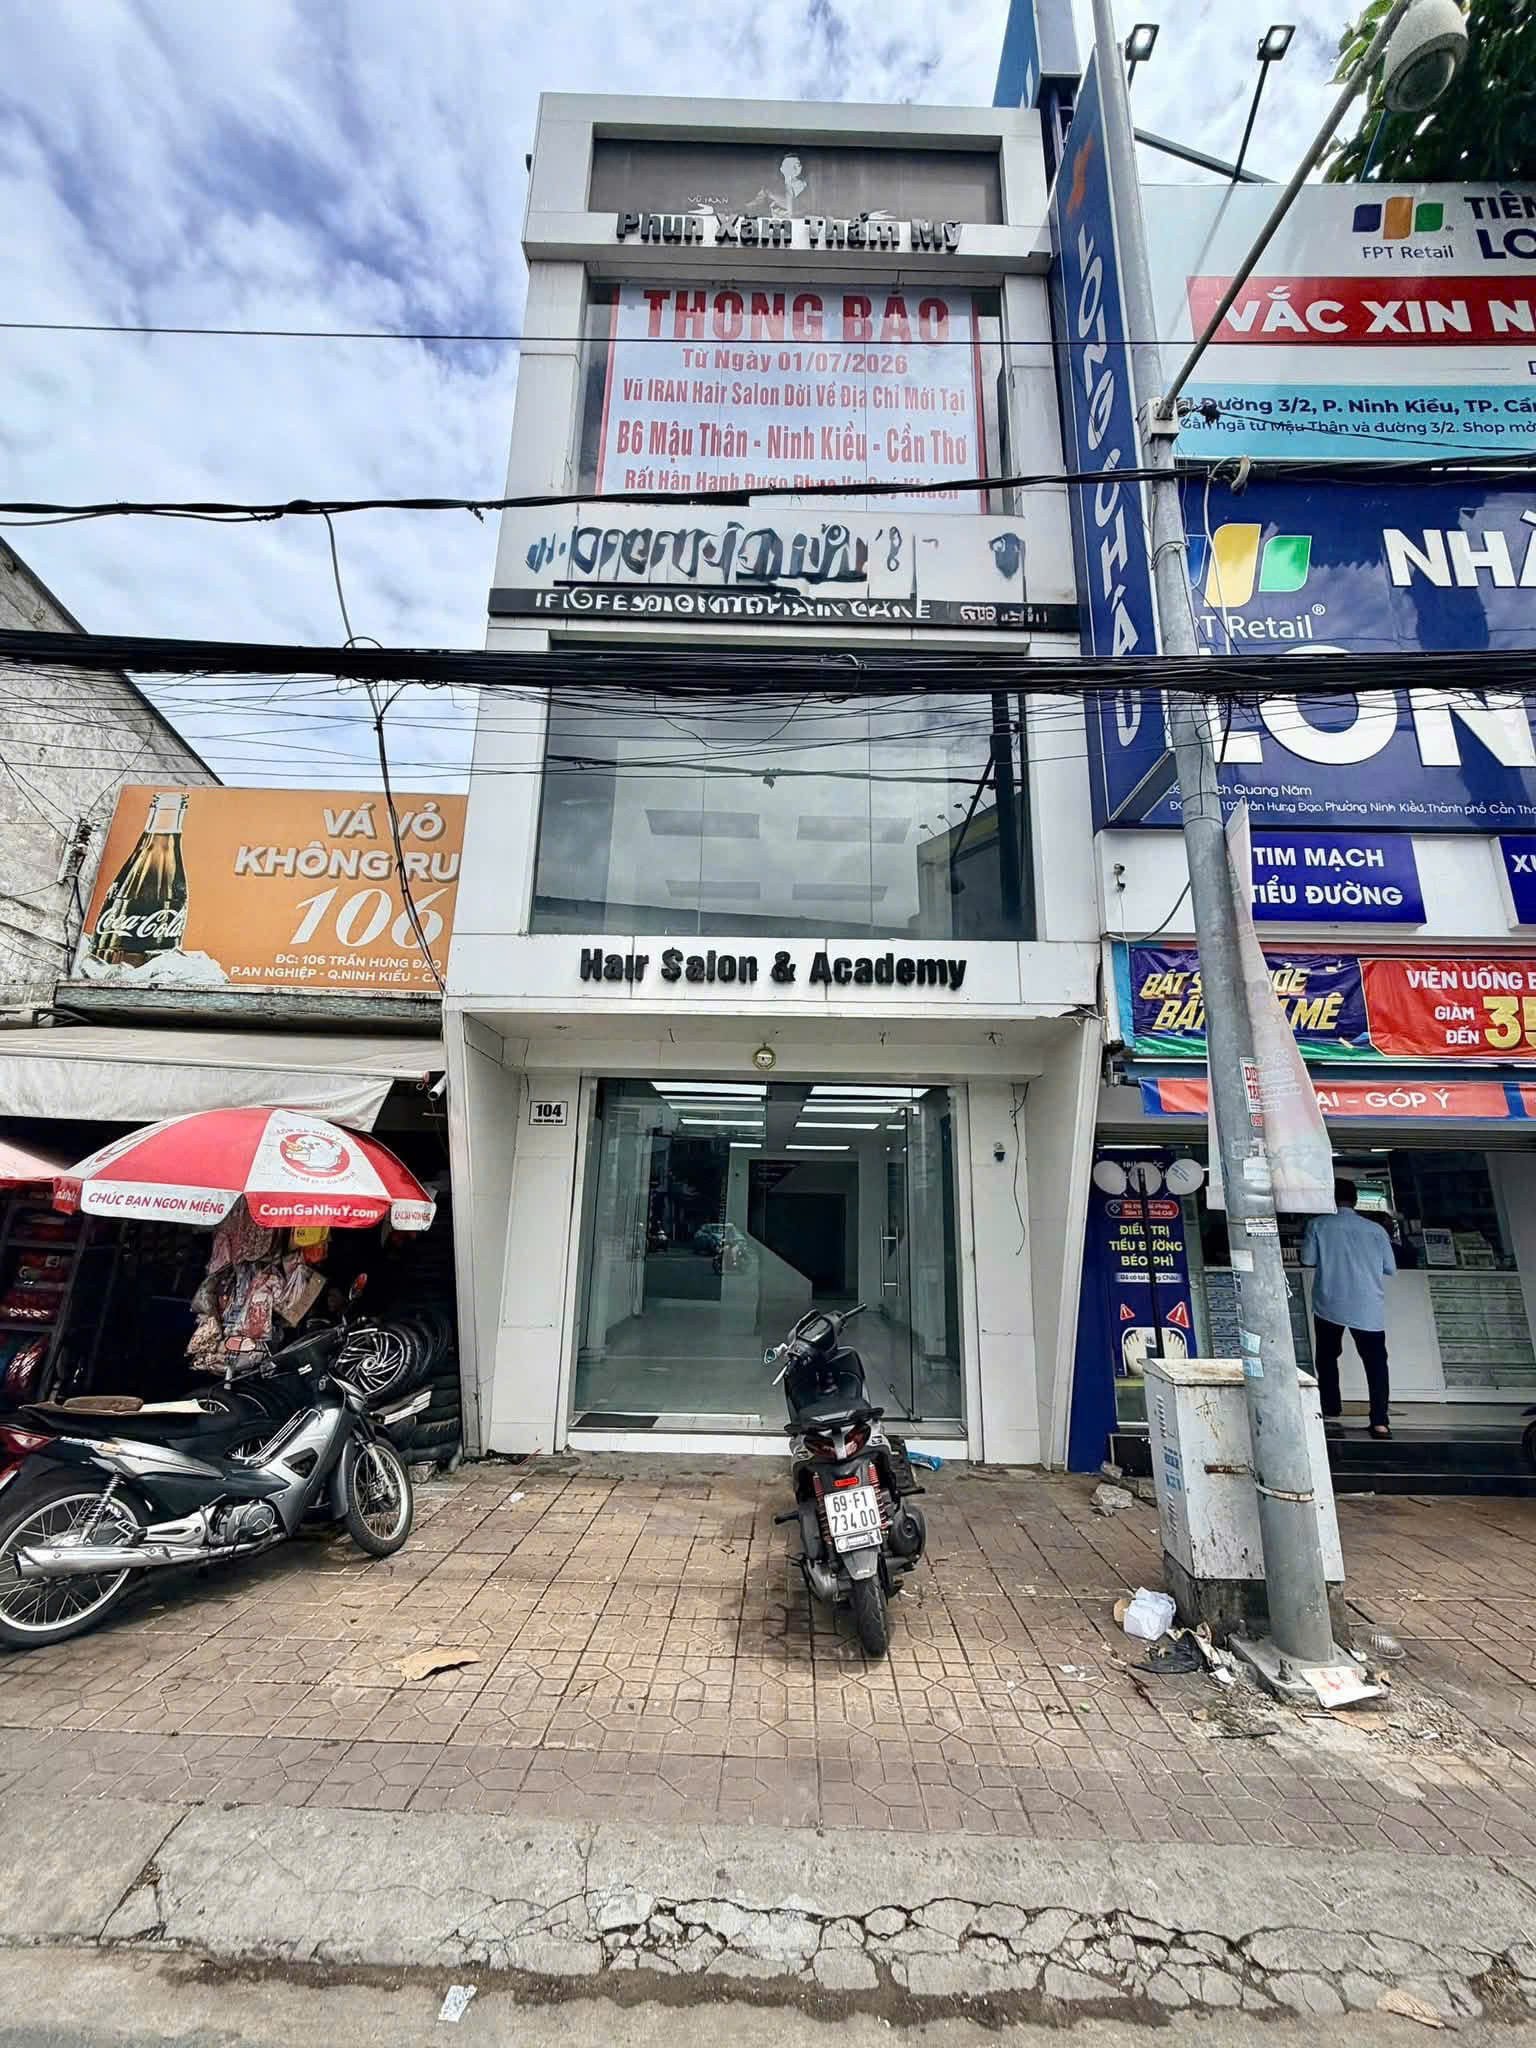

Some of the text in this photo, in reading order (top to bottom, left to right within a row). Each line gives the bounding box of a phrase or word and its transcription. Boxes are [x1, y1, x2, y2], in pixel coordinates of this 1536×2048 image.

[616, 209, 704, 242] Phun
[1363, 245, 1454, 259] FPT Retail
[1216, 286, 1348, 333] VẮC
[1360, 300, 1472, 333] XIN
[1079, 224, 1114, 450] LONG
[682, 347, 908, 375] Từ Ngày 01/07/2026
[623, 377, 643, 401] Vũ
[648, 378, 688, 403] IRAN
[693, 381, 727, 405] Hair
[732, 382, 779, 406] Salon
[784, 382, 811, 407] Dời
[841, 384, 866, 412] Địa
[873, 383, 899, 409] Chỉ
[904, 385, 932, 410] Mới
[940, 387, 965, 416] Tại
[1279, 397, 1317, 415] 3/2,
[1323, 400, 1343, 413] P.
[1349, 398, 1399, 413] Ninh
[1464, 400, 1499, 413] TP.
[1309, 420, 1349, 433] Thân
[1352, 421, 1370, 433] và
[1374, 421, 1427, 435] đường
[1431, 421, 1459, 434] 3/2.
[1463, 421, 1505, 435] Shop
[649, 420, 694, 464] Mậu
[699, 423, 748, 458] Thân
[768, 425, 814, 460] Ninh
[821, 421, 867, 462] Kiều
[887, 422, 925, 464] Cần
[930, 429, 967, 465] Thơ
[625, 465, 654, 490] Rất
[658, 469, 691, 491] Hân
[1229, 614, 1313, 638] Retail
[1234, 784, 1279, 797] Quang
[323, 802, 376, 838] VÁ
[1370, 802, 1396, 813] Ninh
[234, 841, 392, 879] KHÔNG
[1252, 848, 1384, 873] TIM MẠCH
[1304, 878, 1403, 906] ĐƯỜNG
[289, 886, 448, 949] 106
[276, 953, 299, 965] ĐC:
[303, 954, 325, 966] 106
[579, 947, 968, 991] Hair Salon & Academy
[230, 966, 261, 978] P.AN
[264, 966, 317, 979] NGHIỆP
[327, 969, 376, 982] Q.NINH
[1406, 967, 1458, 989] VIÊN
[1366, 1085, 1420, 1109] GÓP
[1427, 1088, 1449, 1109] Ý
[536, 1104, 561, 1117] 104
[88, 1191, 125, 1205] CHÚC
[126, 1194, 151, 1209] BẠN
[152, 1197, 187, 1210] NGON
[189, 1198, 225, 1216] MIỆNG
[260, 1203, 378, 1219] ComGaNhuY.com
[1121, 1254, 1148, 1266] BÉO
